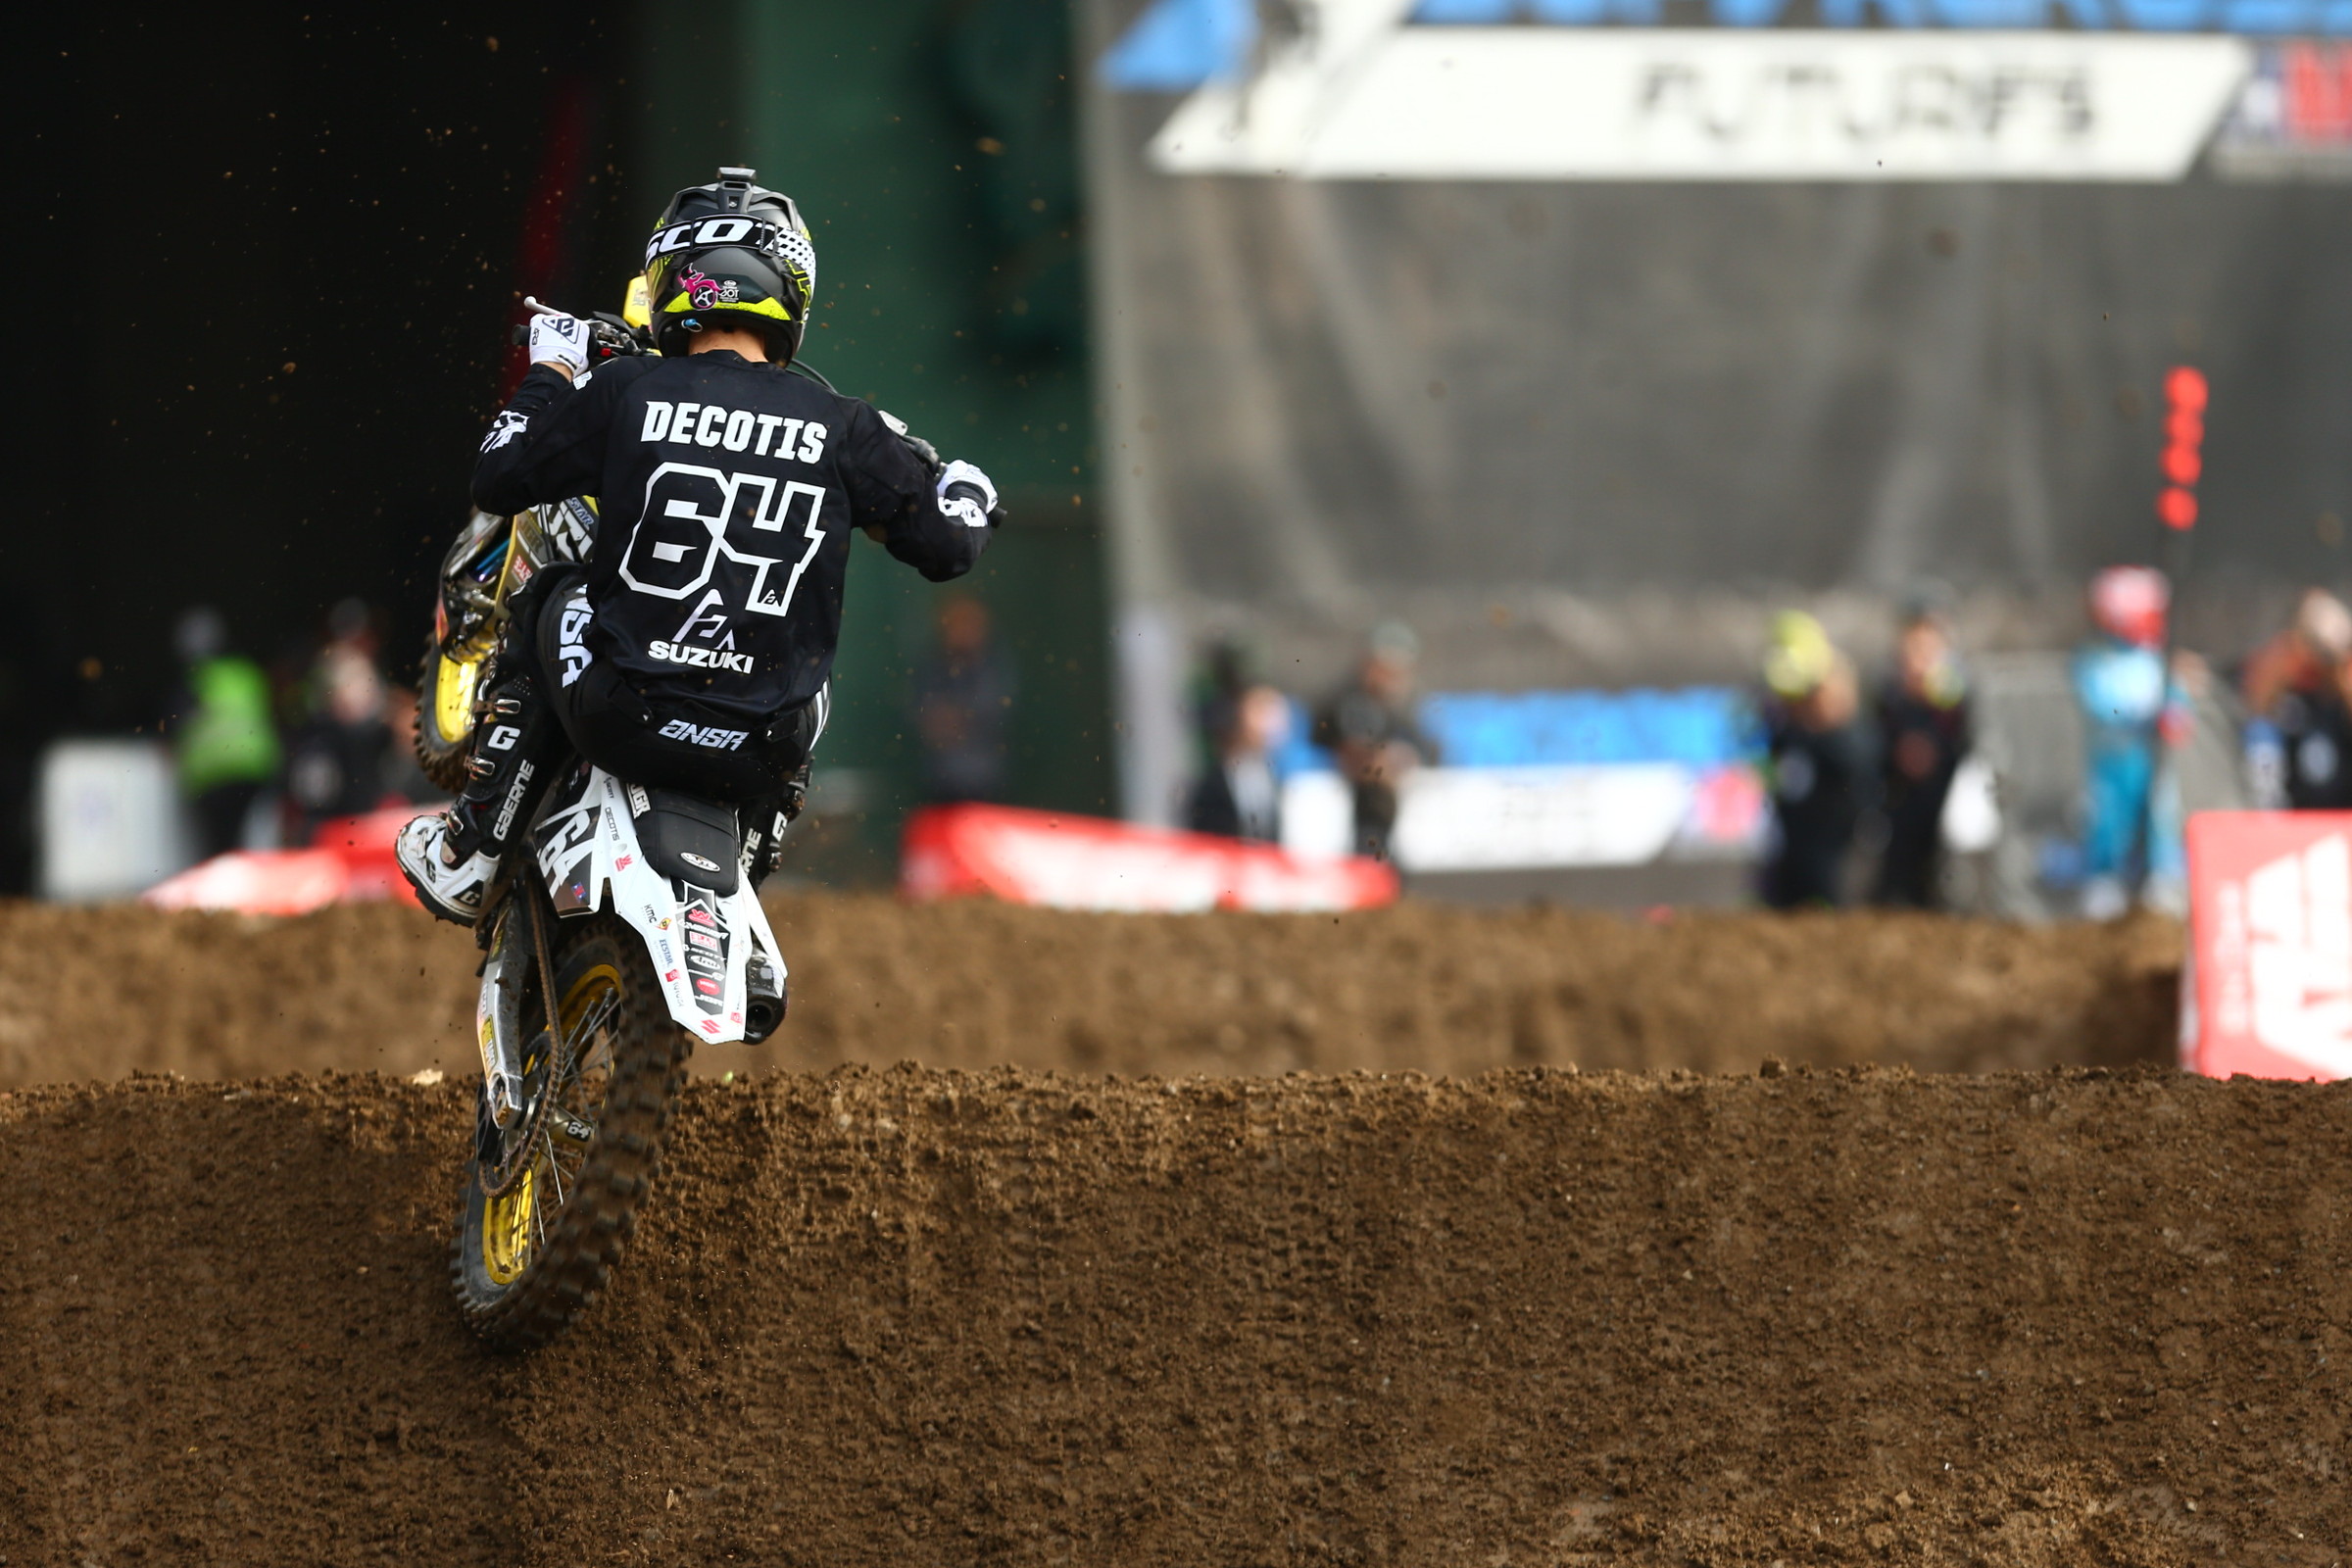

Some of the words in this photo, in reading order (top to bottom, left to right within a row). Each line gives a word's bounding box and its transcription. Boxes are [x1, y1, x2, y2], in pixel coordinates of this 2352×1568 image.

[641, 401, 827, 464] DECOTIS
[618, 462, 826, 616] 64
[648, 640, 754, 674] SUZUKI
[488, 724, 520, 751] G
[630, 784, 651, 817] JGR
[605, 807, 620, 841] DECOTIS
